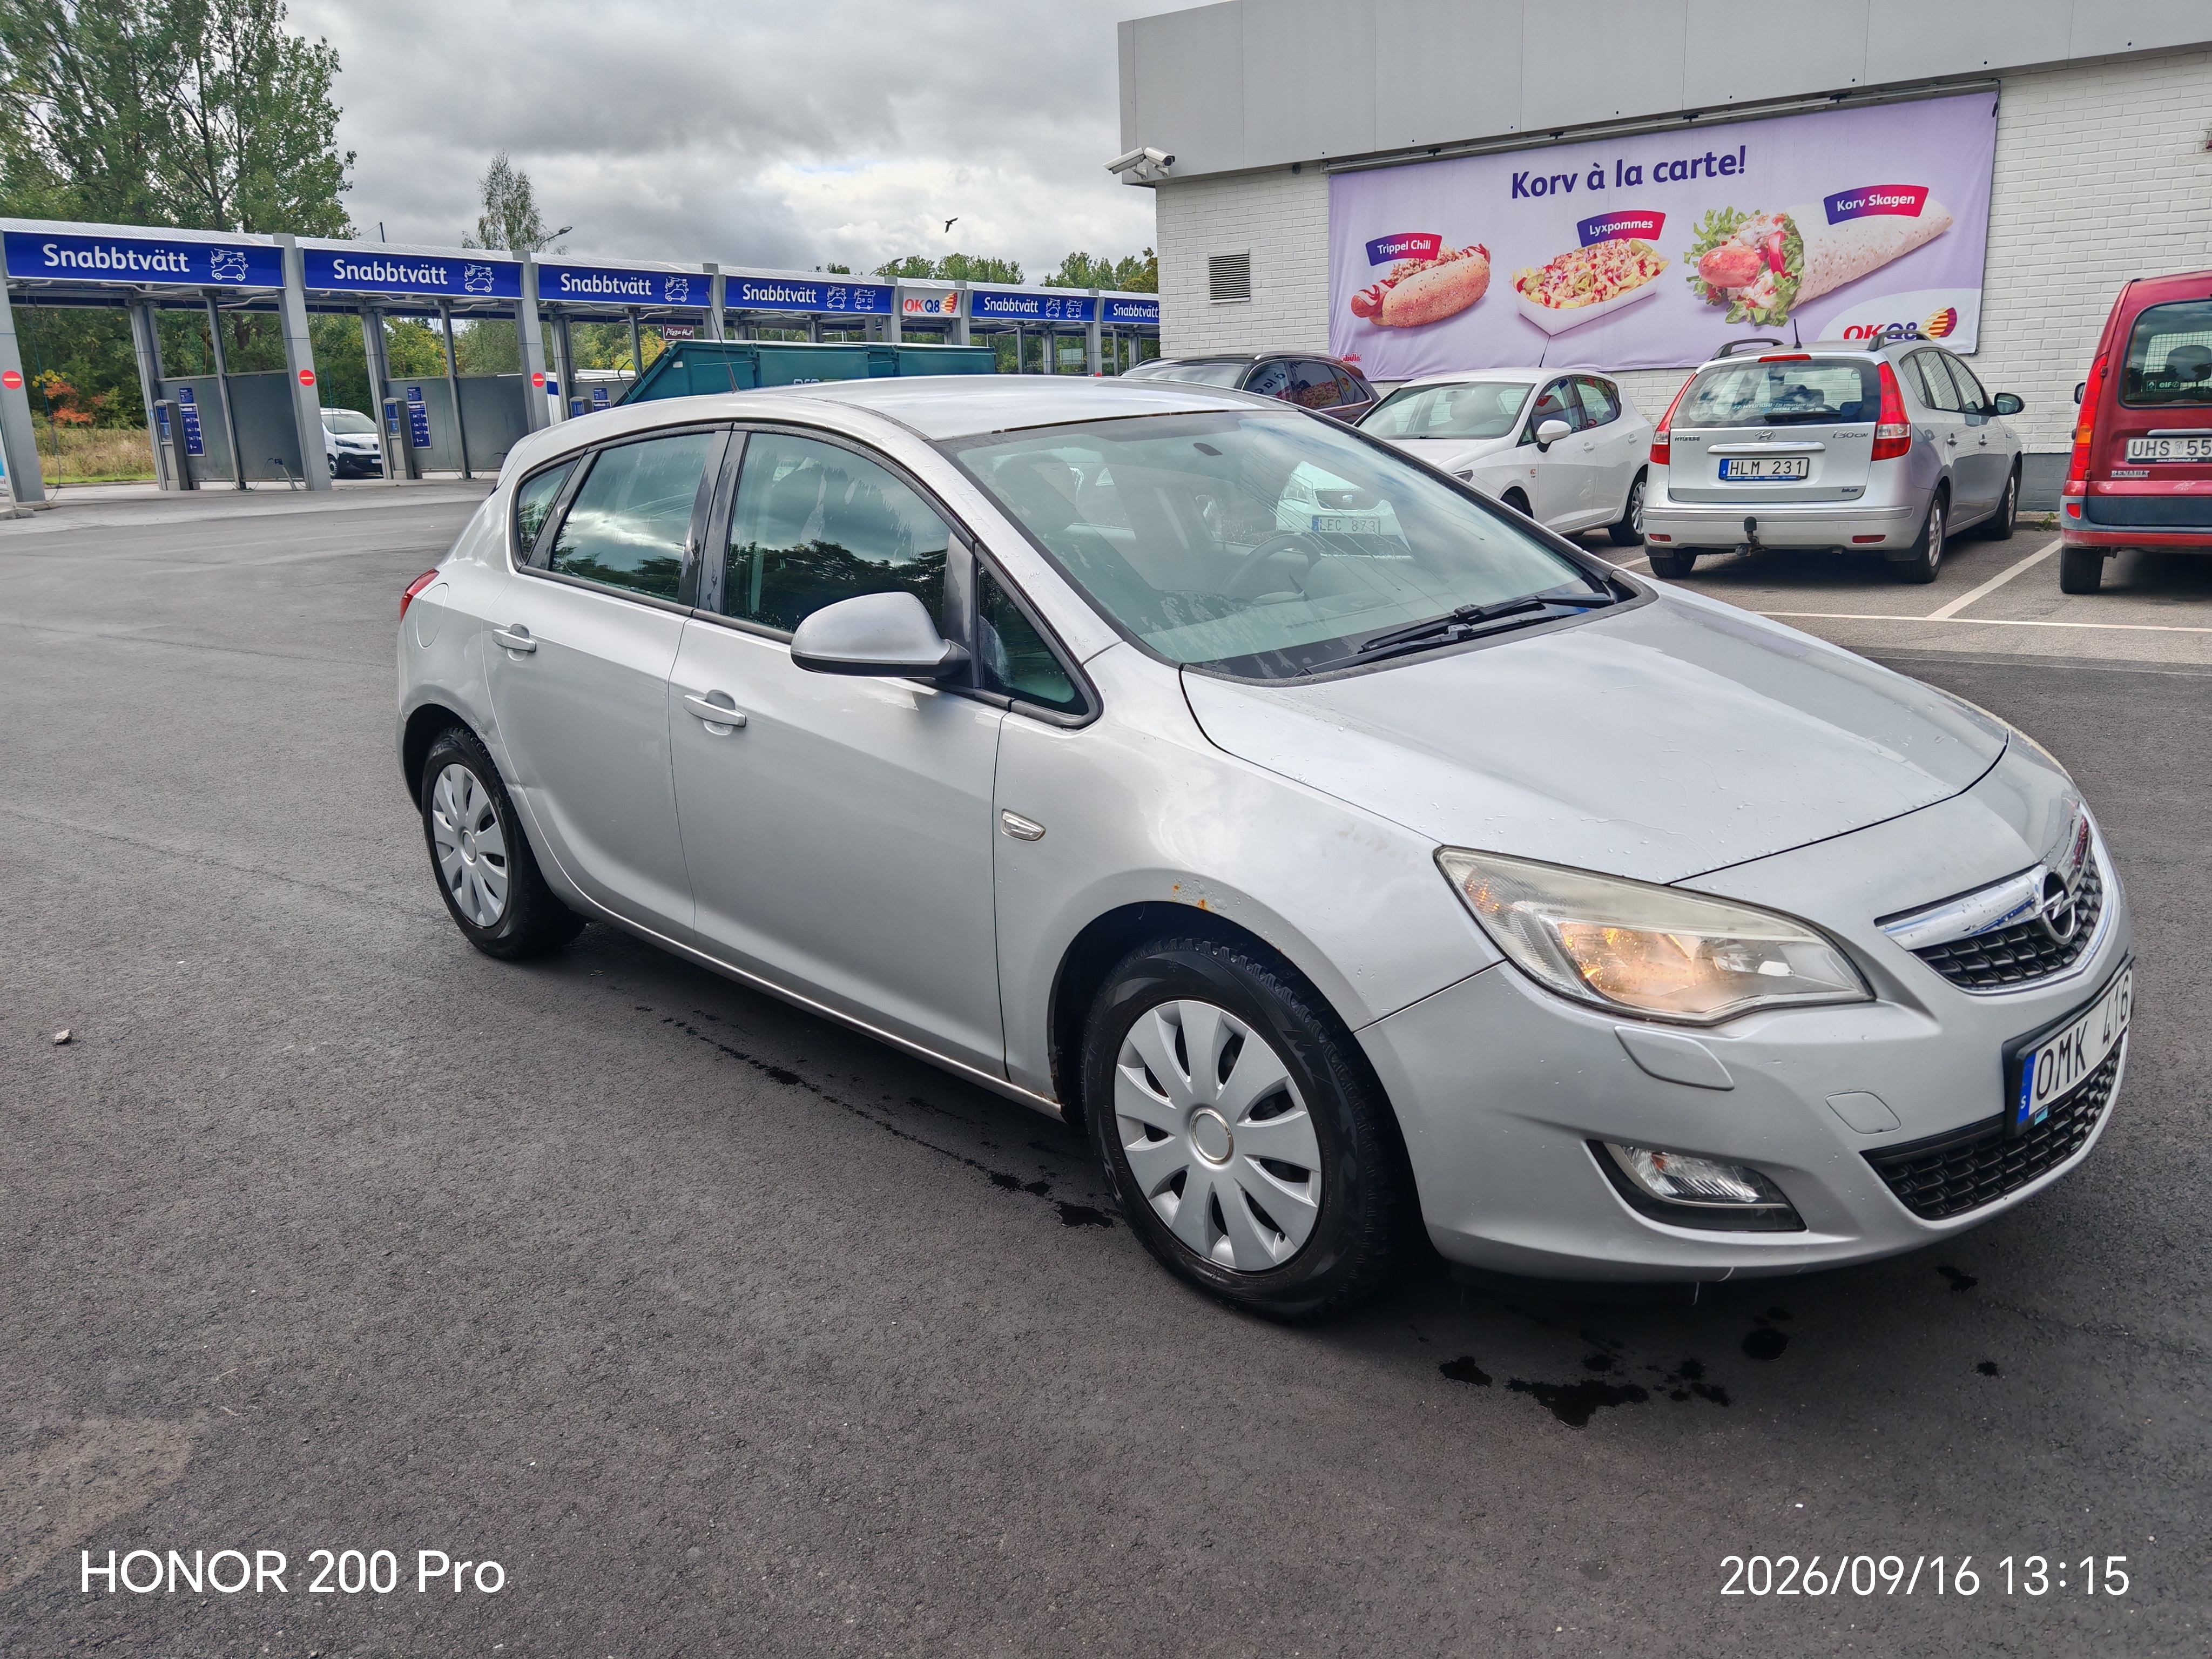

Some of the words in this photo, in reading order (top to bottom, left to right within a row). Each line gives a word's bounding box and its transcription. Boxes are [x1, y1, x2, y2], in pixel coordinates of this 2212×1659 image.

[1512, 171, 1579, 199] Korv
[1587, 162, 1606, 191] à
[1615, 159, 1643, 187] la
[1653, 145, 1746, 183] carte!
[1837, 199, 1866, 212] Korv
[1869, 194, 1915, 207] Skagen
[1589, 219, 1654, 237] Lyxpommes
[1377, 240, 1408, 255] Trippel
[1411, 240, 1431, 250] Chili
[43, 244, 190, 273] Snabbtvätt
[333, 260, 448, 286] Snabbtvätt
[561, 273, 652, 296] Snabbtvätt
[743, 284, 817, 304] Snabbtvätt
[904, 298, 940, 313] OKQ8
[984, 296, 1038, 313] Snabbtvätt
[1113, 304, 1158, 318] Snabbtvätt
[665, 328, 681, 336] Pizza
[1844, 322, 1917, 340] OKQ8
[2133, 440, 2170, 456] UHS
[2187, 439, 2211, 456] 55
[1730, 461, 1760, 475] HLM
[1772, 461, 1802, 474] 231
[1320, 519, 1342, 531] LEC
[1352, 520, 1375, 532] 873
[2036, 1020, 2088, 1101] OMK
[2102, 974, 2129, 1046] 416
[2020, 1095, 2027, 1109] S
